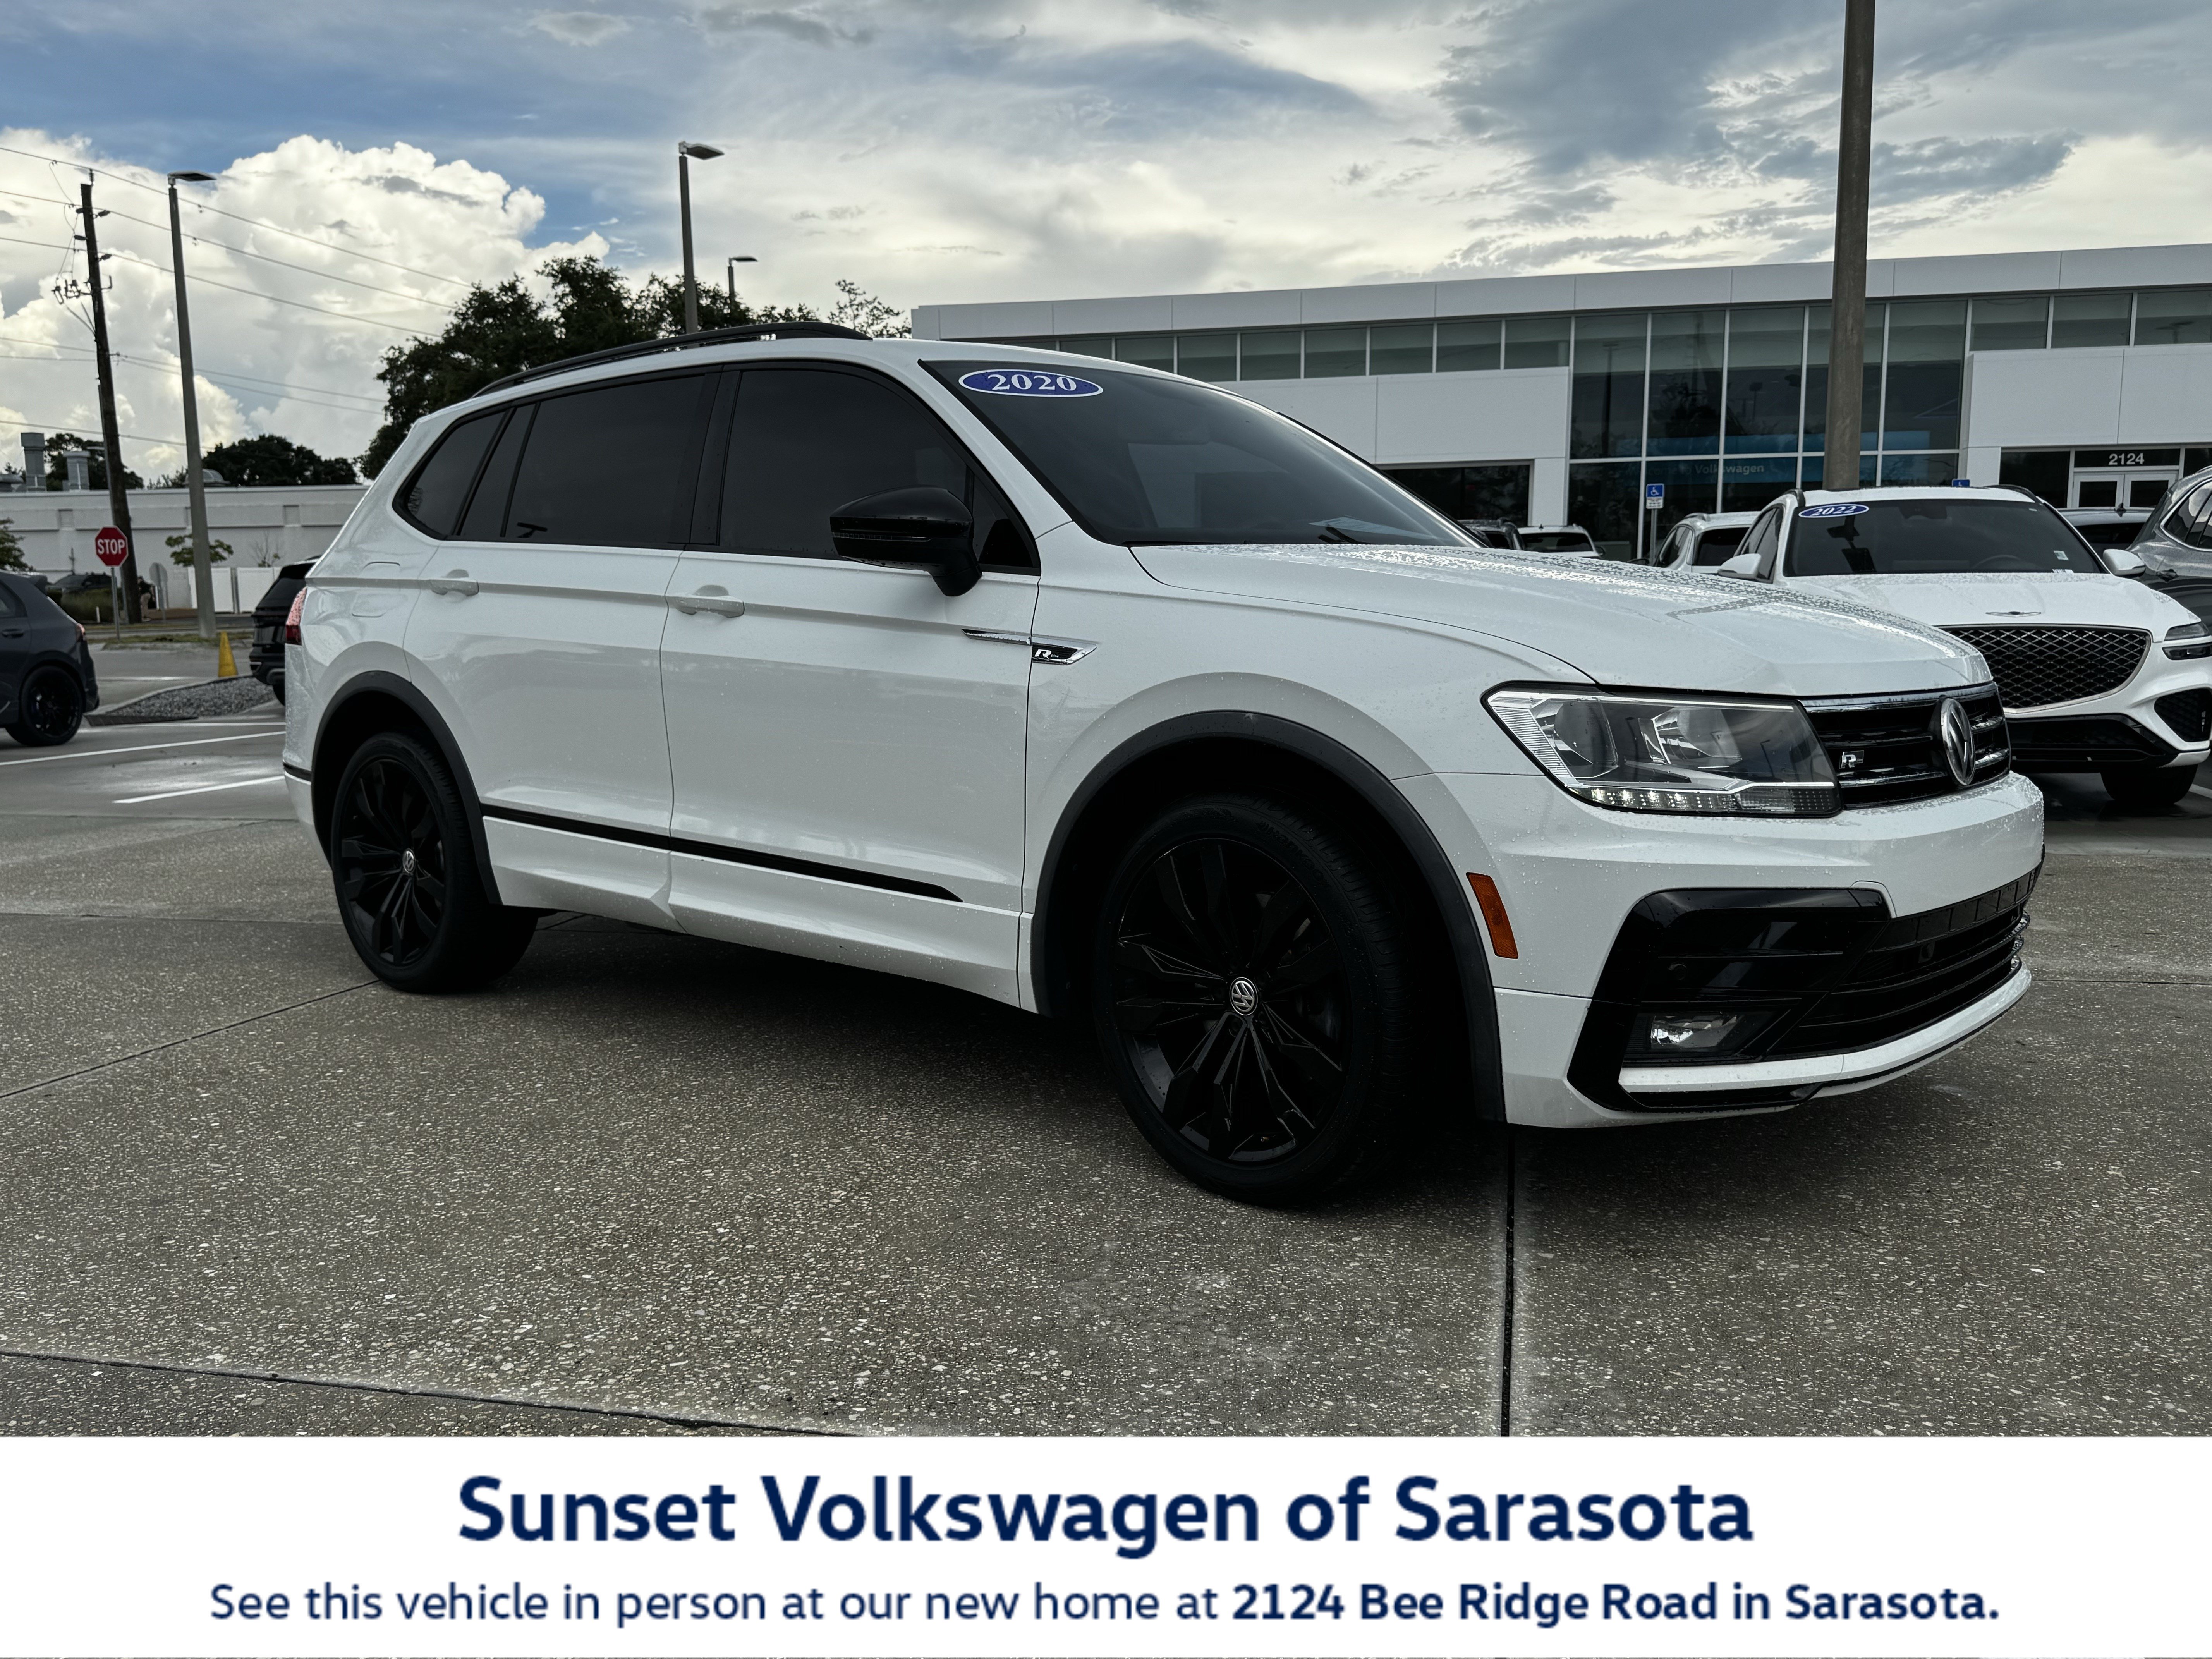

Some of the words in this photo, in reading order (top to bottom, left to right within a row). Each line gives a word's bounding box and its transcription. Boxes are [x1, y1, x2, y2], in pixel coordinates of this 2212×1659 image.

[988, 374, 1077, 391] 2020
[2108, 452, 2145, 465] 2124
[1810, 505, 1857, 517] 2022
[98, 538, 125, 555] STOP
[1841, 754, 1857, 769] R
